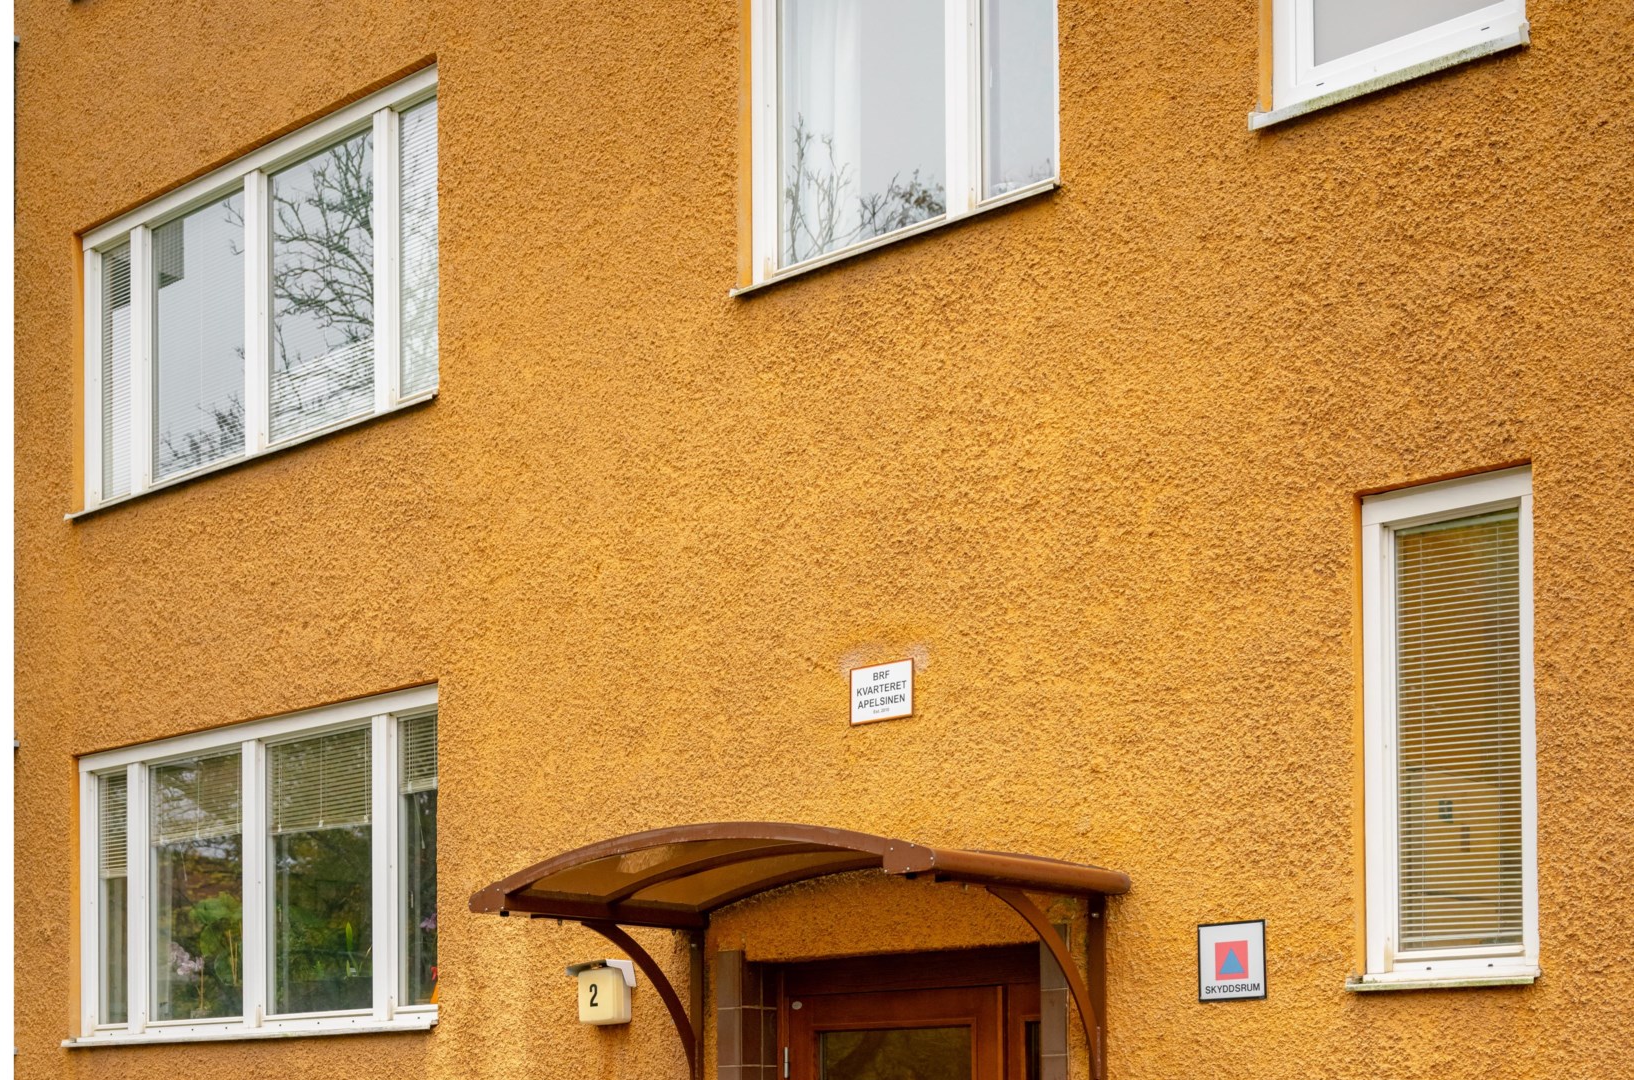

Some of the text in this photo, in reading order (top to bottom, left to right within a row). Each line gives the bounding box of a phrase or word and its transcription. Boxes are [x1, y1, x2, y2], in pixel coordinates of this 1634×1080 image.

[873, 670, 890, 681] BRF
[856, 680, 907, 696] KVARTERET
[857, 694, 906, 709] APELSINEN
[589, 983, 598, 1007] 2
[1205, 983, 1261, 994] SKYDDSRUM
